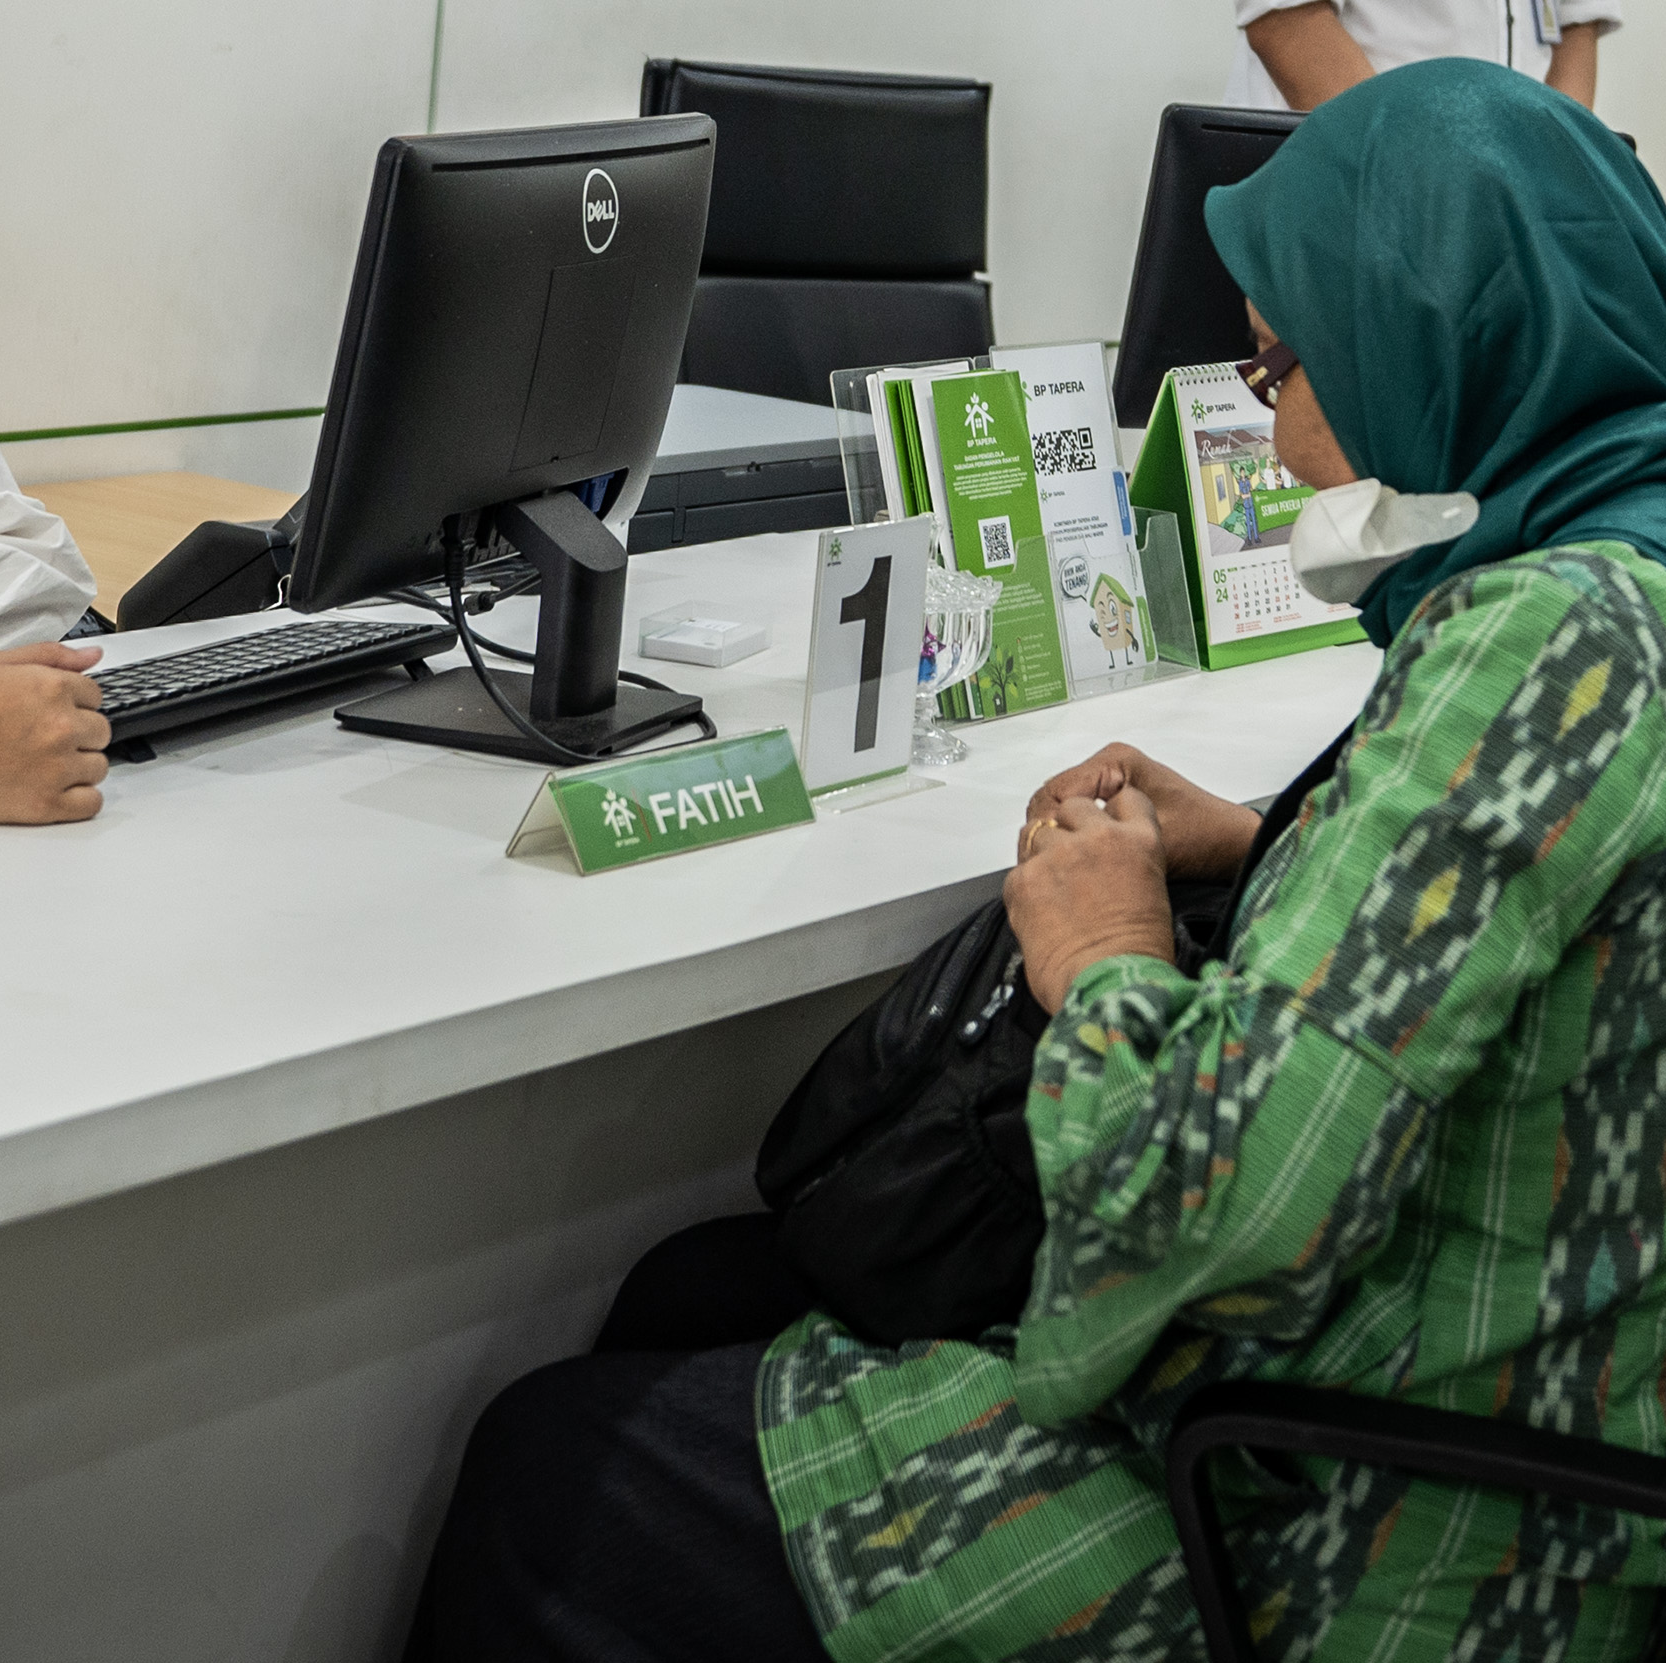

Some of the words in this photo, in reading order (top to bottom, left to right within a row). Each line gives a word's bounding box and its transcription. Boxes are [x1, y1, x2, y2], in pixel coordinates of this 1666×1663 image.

[587, 200, 615, 222] DELL
[1034, 385, 1046, 396] BP
[1048, 381, 1085, 395] TAPERA
[1206, 405, 1214, 413] BP
[1215, 403, 1236, 412] TAPERA
[1213, 569, 1227, 584] 05
[1215, 587, 1229, 603] 24
[840, 555, 892, 753] 1
[648, 774, 764, 834] FATIH
